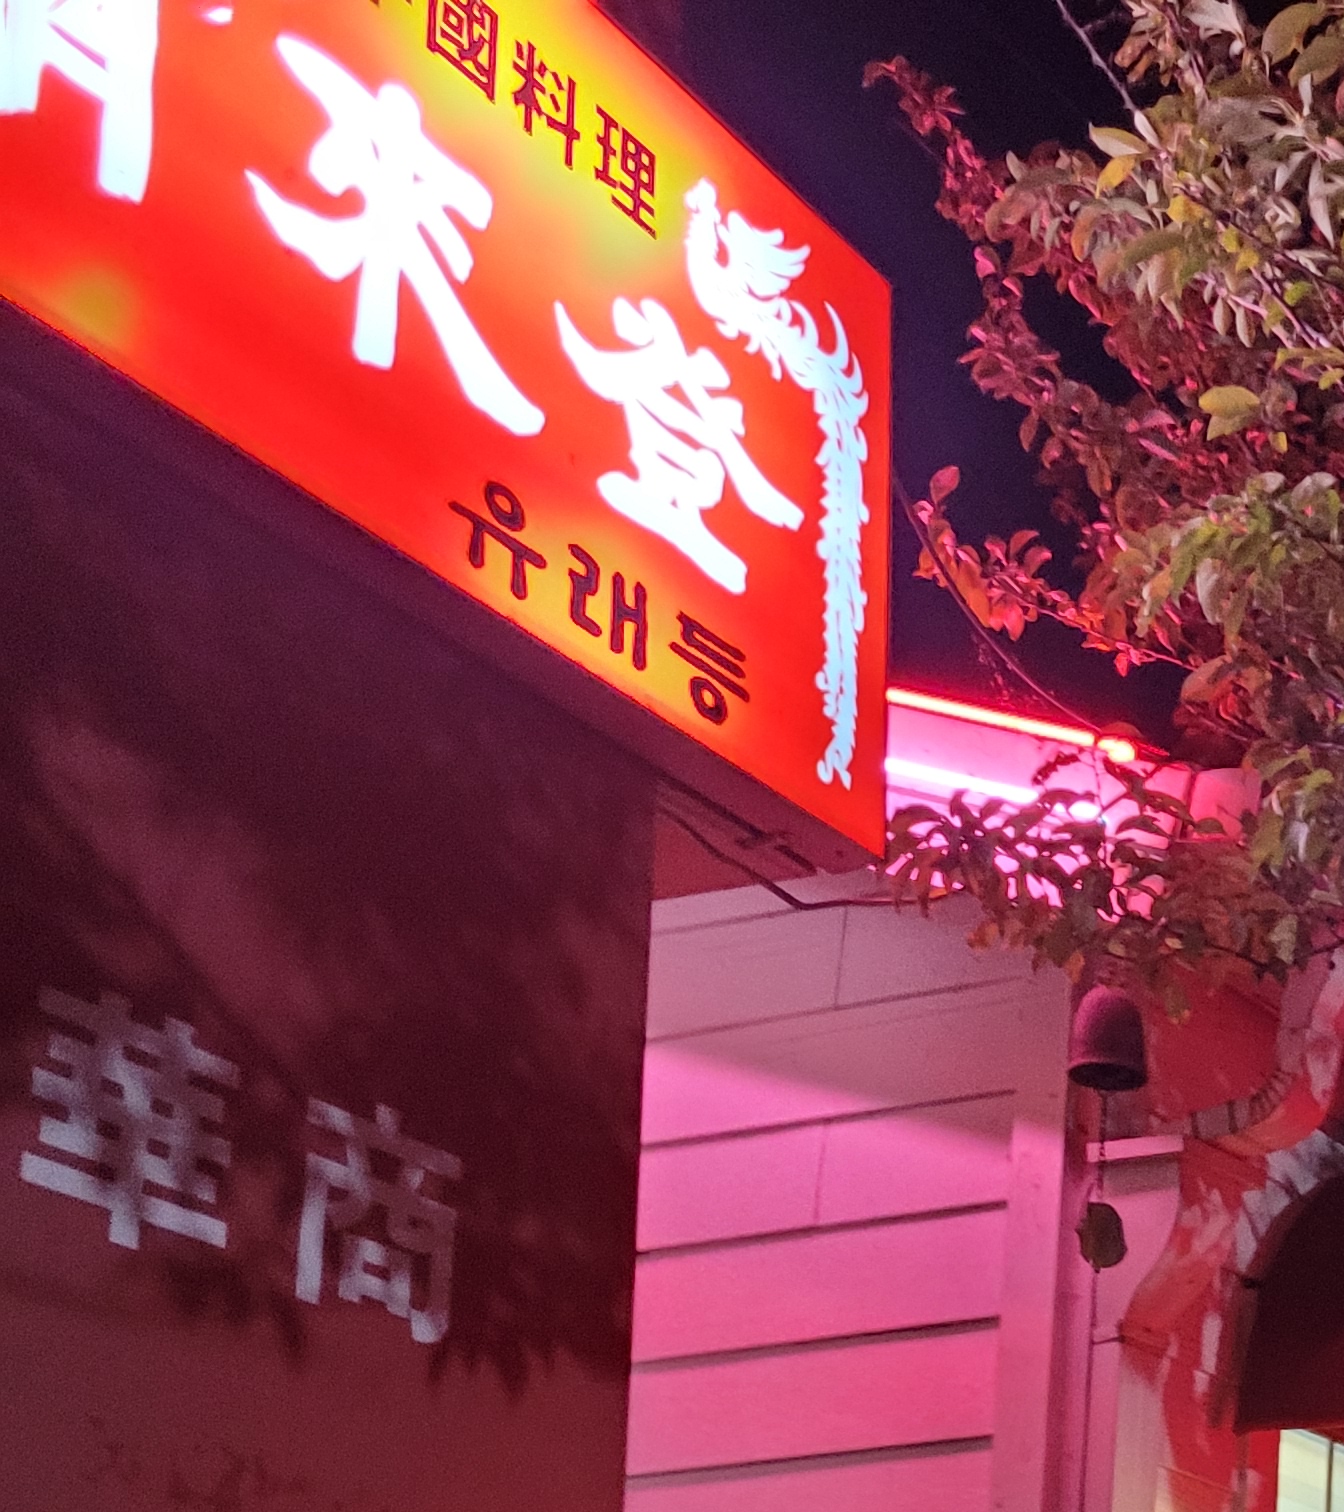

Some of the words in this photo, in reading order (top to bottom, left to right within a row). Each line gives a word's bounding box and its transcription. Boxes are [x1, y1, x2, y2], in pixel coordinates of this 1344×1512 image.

[370, 0, 658, 240] 國料理
[449, 481, 750, 726] 유래등
[20, 985, 463, 1344] 華商
